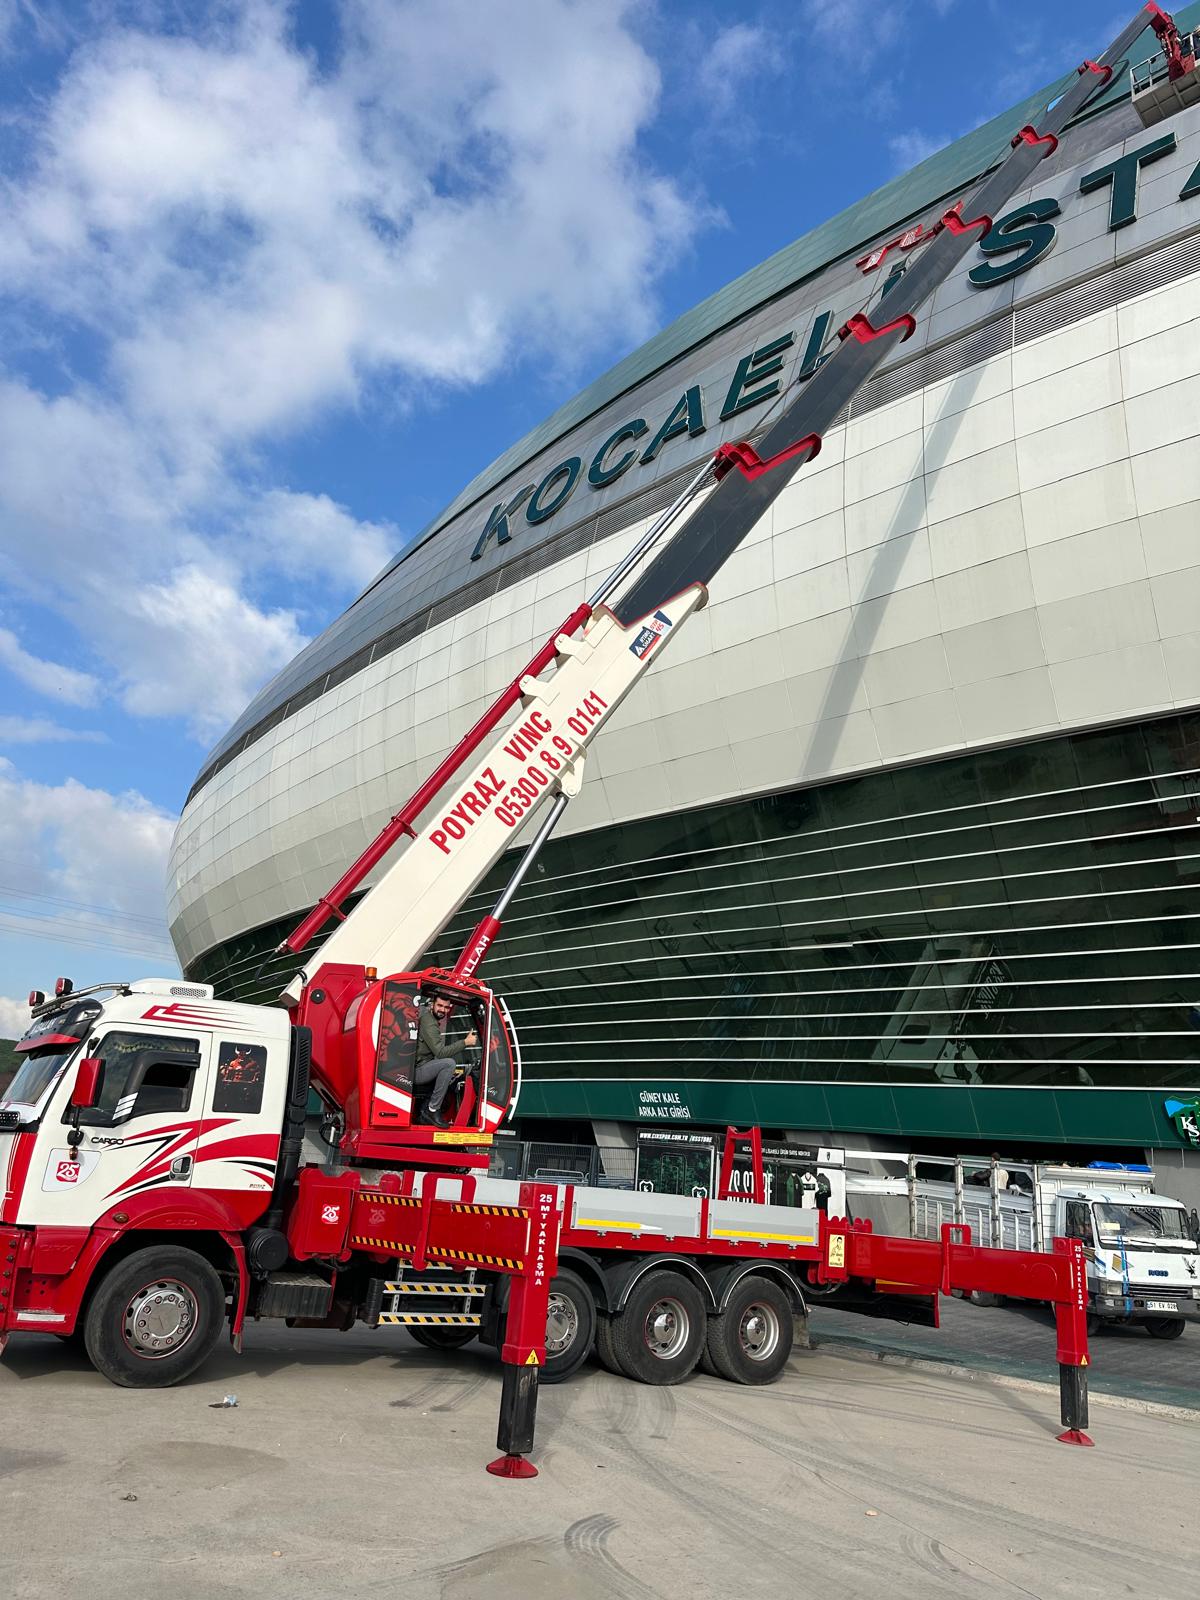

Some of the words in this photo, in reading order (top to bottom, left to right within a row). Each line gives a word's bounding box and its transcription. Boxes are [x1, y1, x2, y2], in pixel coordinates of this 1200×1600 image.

[968, 131, 1200, 288] ST
[567, 690, 608, 736] 0141
[429, 767, 506, 855] POYRAZ
[503, 711, 552, 762] VİNÇ
[640, 1090, 661, 1103] GÜNEY
[662, 1092, 681, 1104] KALE
[639, 1106, 657, 1117] ARKA
[657, 1106, 669, 1118] ALT
[670, 1104, 691, 1120] GİRİŞİ
[91, 1136, 124, 1145] CARGO
[56, 1162, 80, 1178] 25
[540, 1194, 552, 1204] 25
[321, 1205, 340, 1219] 25
[535, 1223, 547, 1286] YAKLAŞMA
